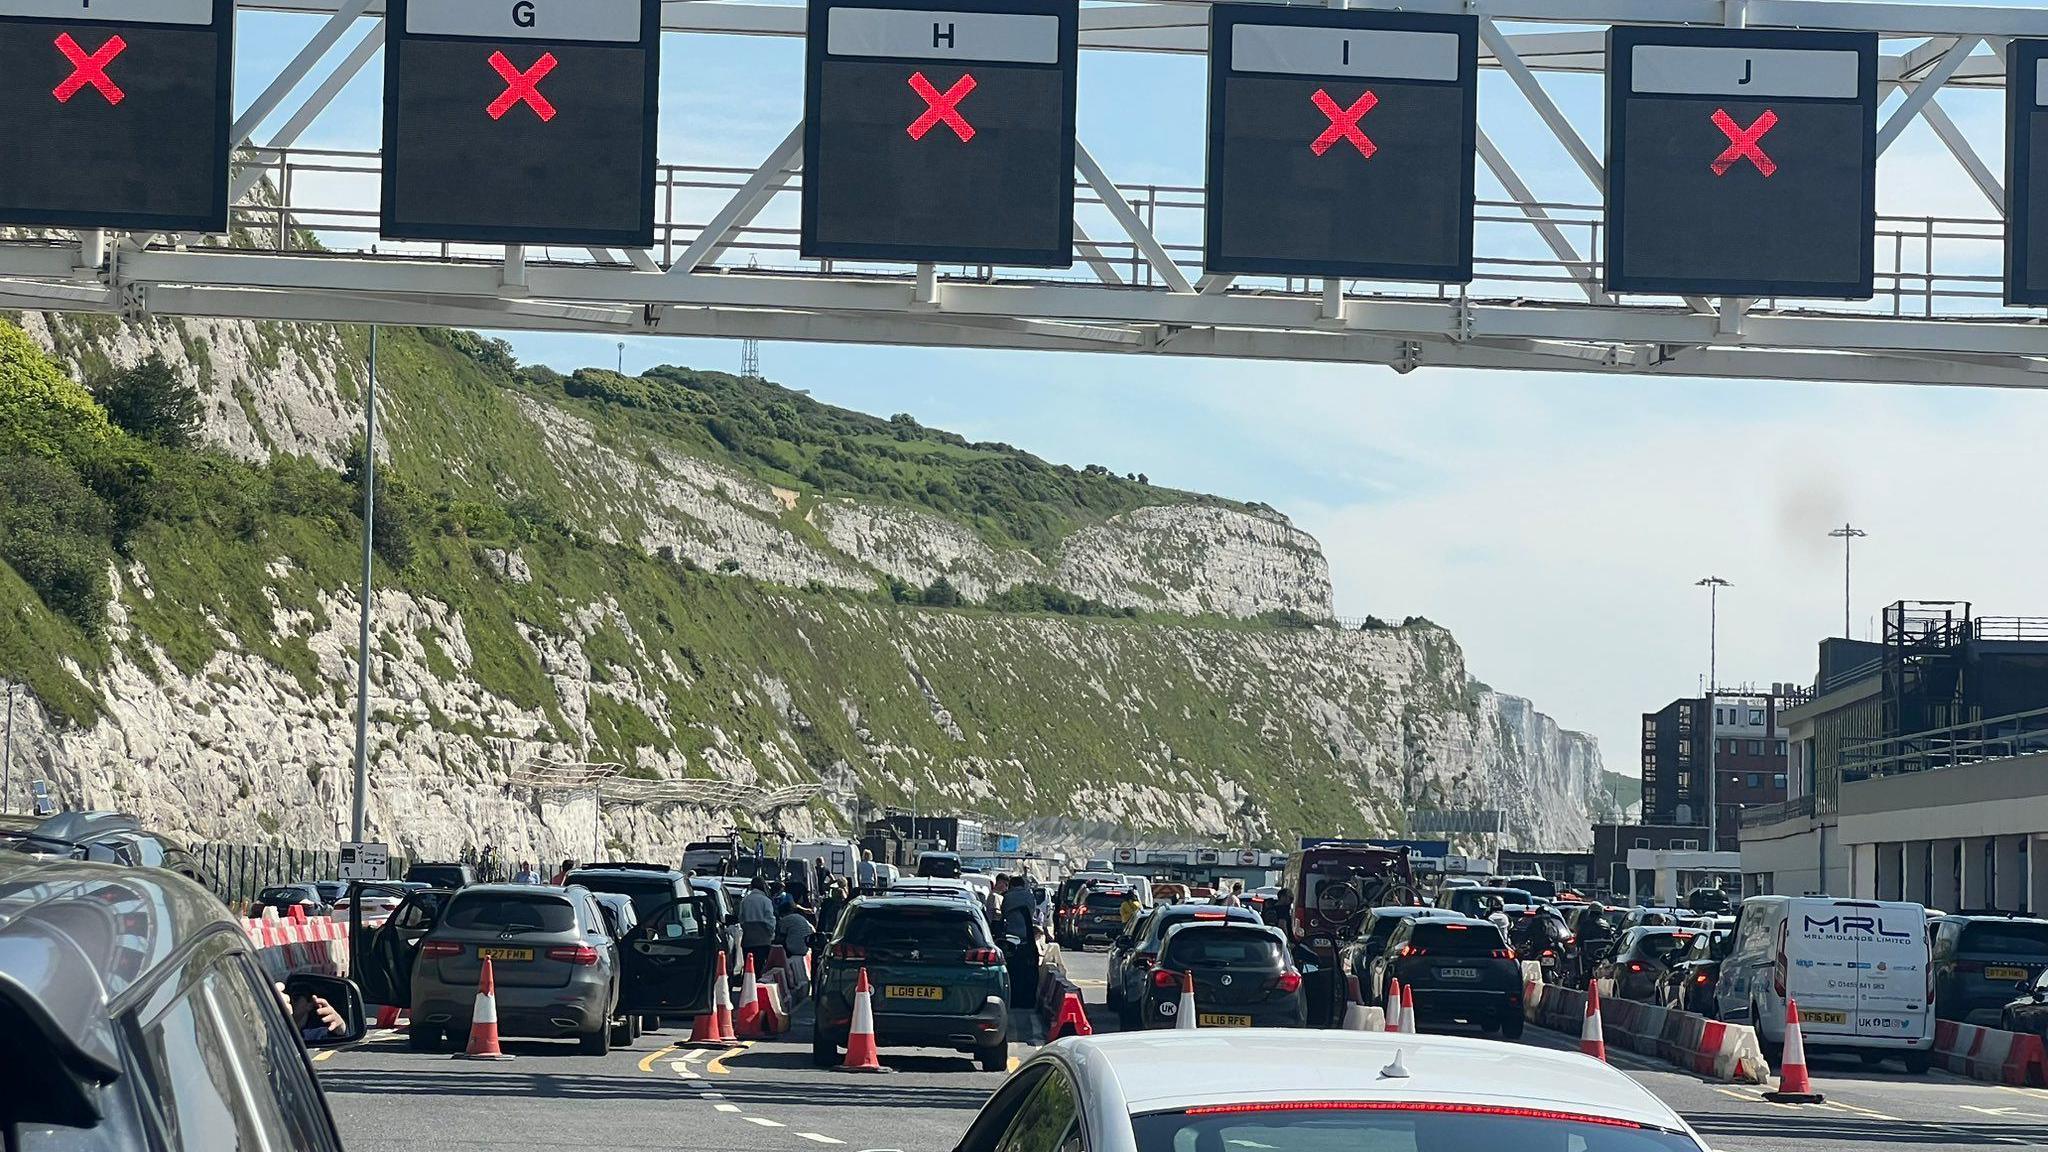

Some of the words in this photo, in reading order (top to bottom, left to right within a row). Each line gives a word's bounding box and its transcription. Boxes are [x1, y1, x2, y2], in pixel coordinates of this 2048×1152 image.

[512, 1, 535, 28] G
[933, 23, 954, 48] H
[1343, 40, 1349, 65] I
[1738, 59, 1751, 84] J
[1804, 914, 1910, 938] MRL
[1825, 934, 1873, 942] MIDLANDS
[1876, 936, 1911, 945] LIMITED
[892, 987, 914, 997] LG19
[917, 987, 936, 997] EAF
[1162, 1004, 1174, 1013] UK
[1205, 1015, 1226, 1025] LL16
[1858, 1018, 1872, 1027] UK
